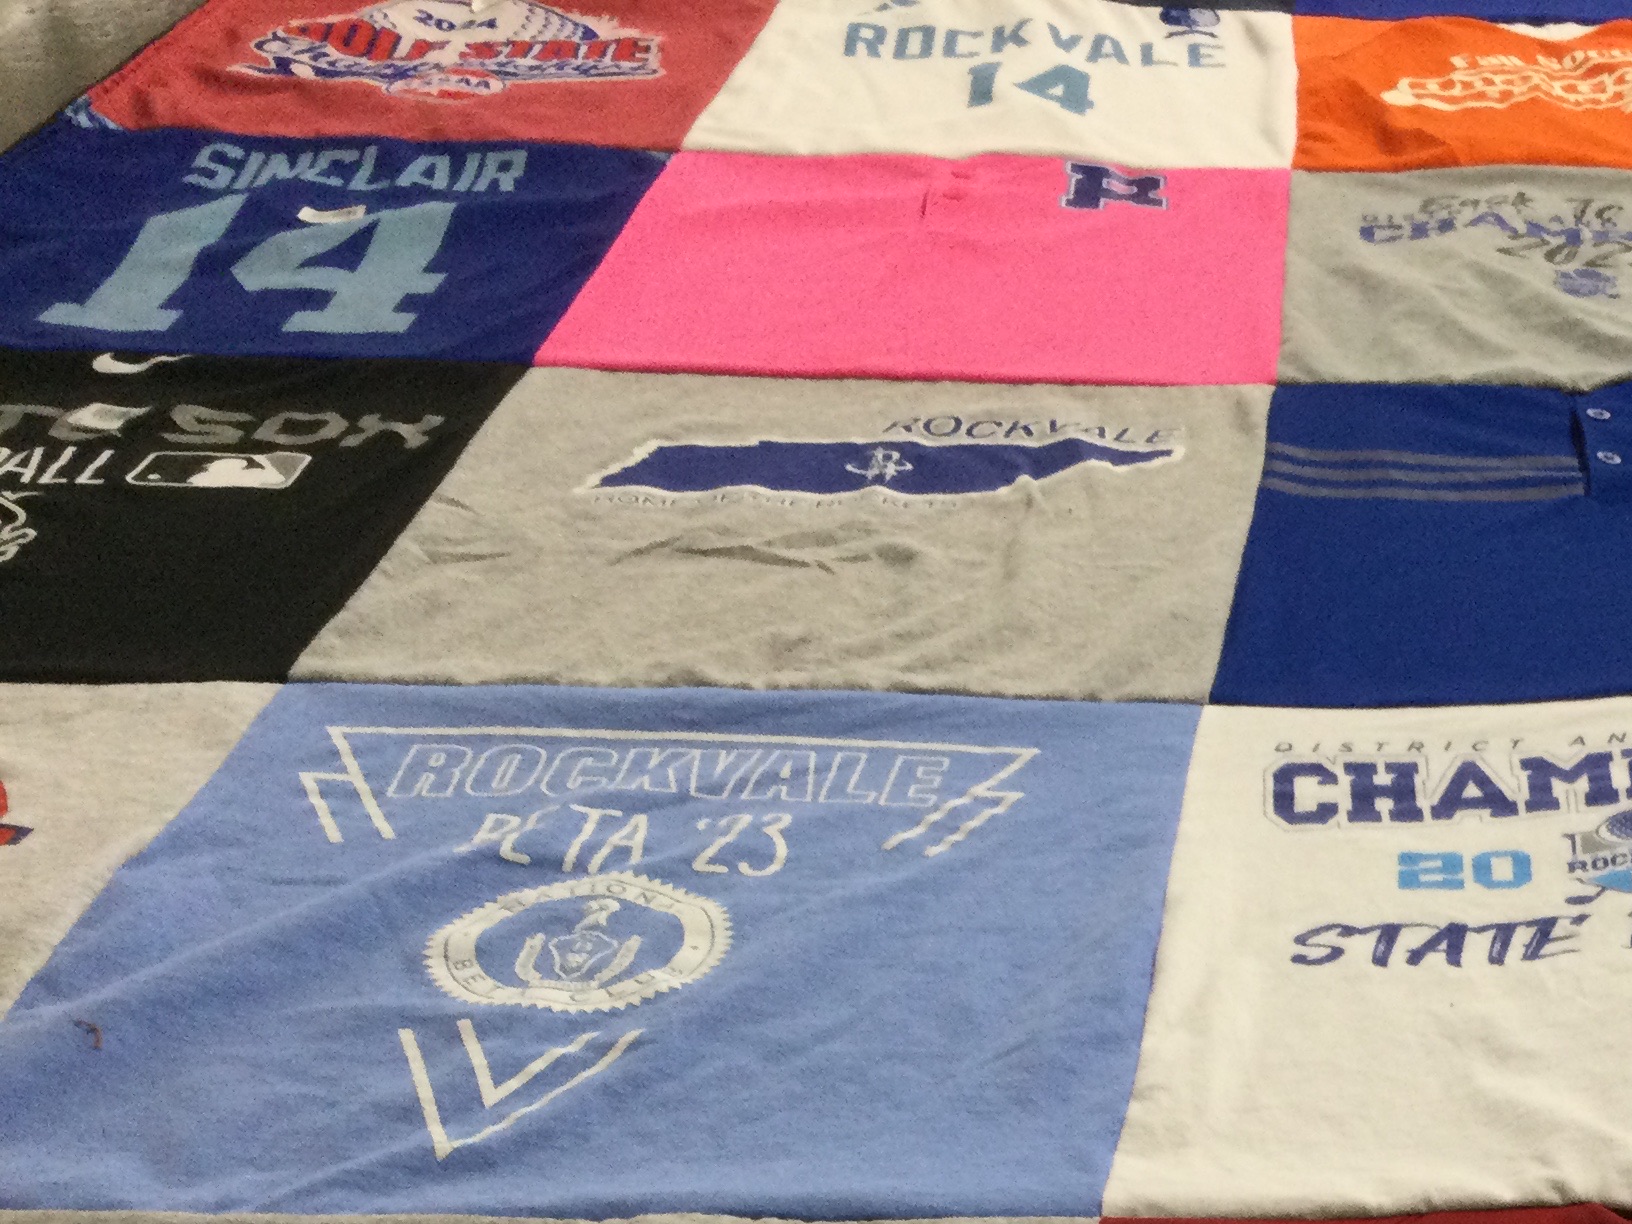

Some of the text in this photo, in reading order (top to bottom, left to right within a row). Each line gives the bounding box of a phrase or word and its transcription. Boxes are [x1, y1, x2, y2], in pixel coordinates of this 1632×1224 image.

[843, 18, 1225, 69] ROCKVALE
[966, 62, 1095, 116] 14
[183, 143, 528, 193] SINCLAIR
[37, 193, 457, 334] 14
[160, 404, 445, 450] SOX
[1273, 738, 1526, 753] DISTRICT
[386, 741, 953, 808] ROCKVALE
[694, 811, 794, 878] '23
[1397, 849, 1533, 890] 20
[1290, 913, 1592, 968] STATE
